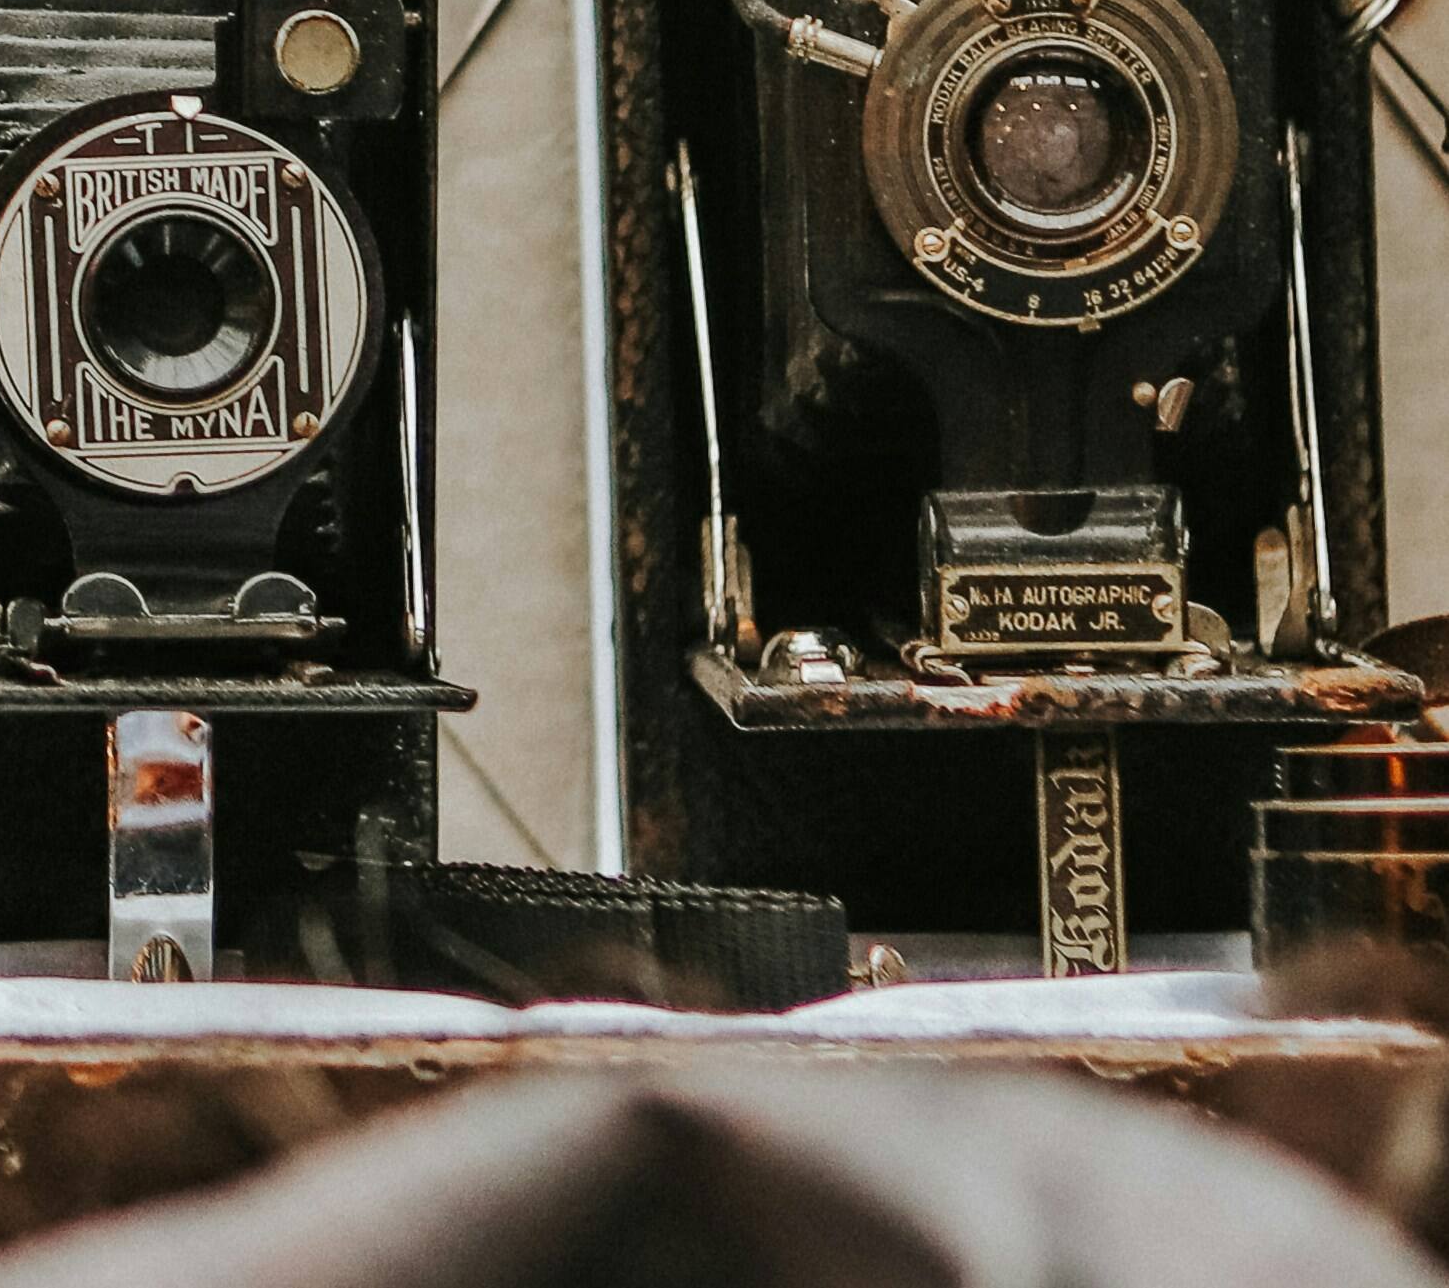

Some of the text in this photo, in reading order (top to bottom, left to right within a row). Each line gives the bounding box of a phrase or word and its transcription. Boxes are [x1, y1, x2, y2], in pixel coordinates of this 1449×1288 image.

[1085, 23, 1153, 85] SHUTTER
[73, 165, 269, 245] BRITISH MADE
[1083, 289, 1103, 307] 16
[1108, 278, 1130, 298] 32
[84, 370, 276, 442] THE MYNA
[1022, 584, 1152, 606] AUTOGRAPHIC
[998, 611, 1127, 632] KODAK JR.
